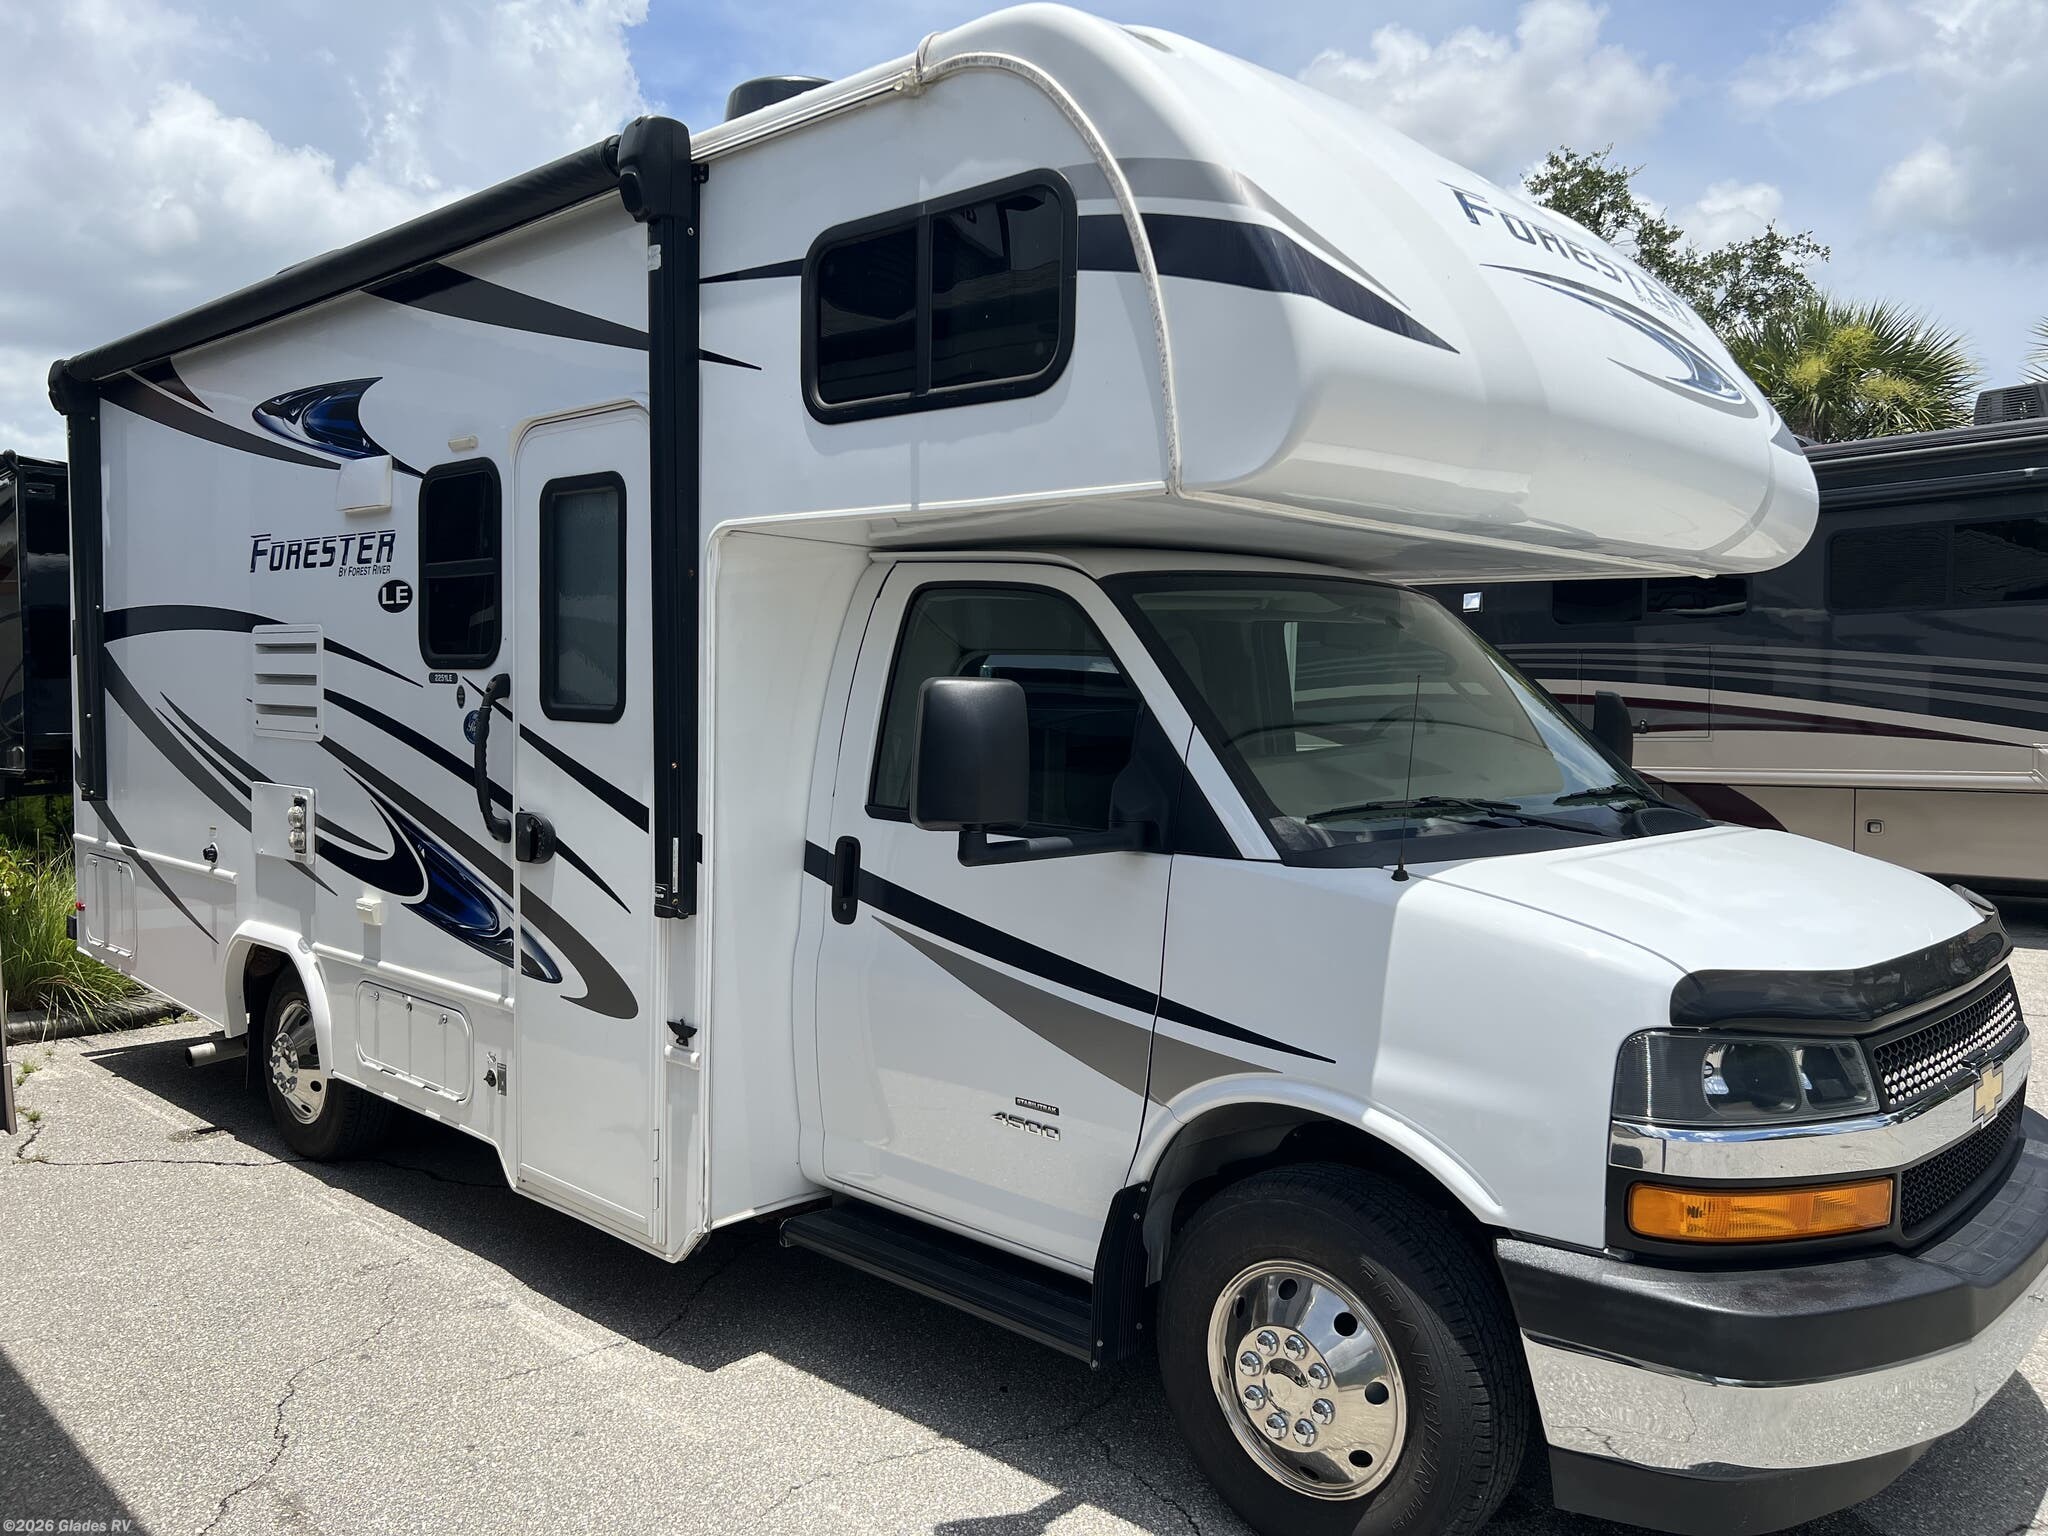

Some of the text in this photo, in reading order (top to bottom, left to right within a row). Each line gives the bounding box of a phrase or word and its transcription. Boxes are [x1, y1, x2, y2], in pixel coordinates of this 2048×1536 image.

[1437, 180, 1690, 322] FORESTER
[249, 529, 396, 573] FORESTER
[338, 564, 391, 577] BY FOREST RIVER
[382, 585, 409, 605] LE
[990, 1111, 1061, 1141] 4500
